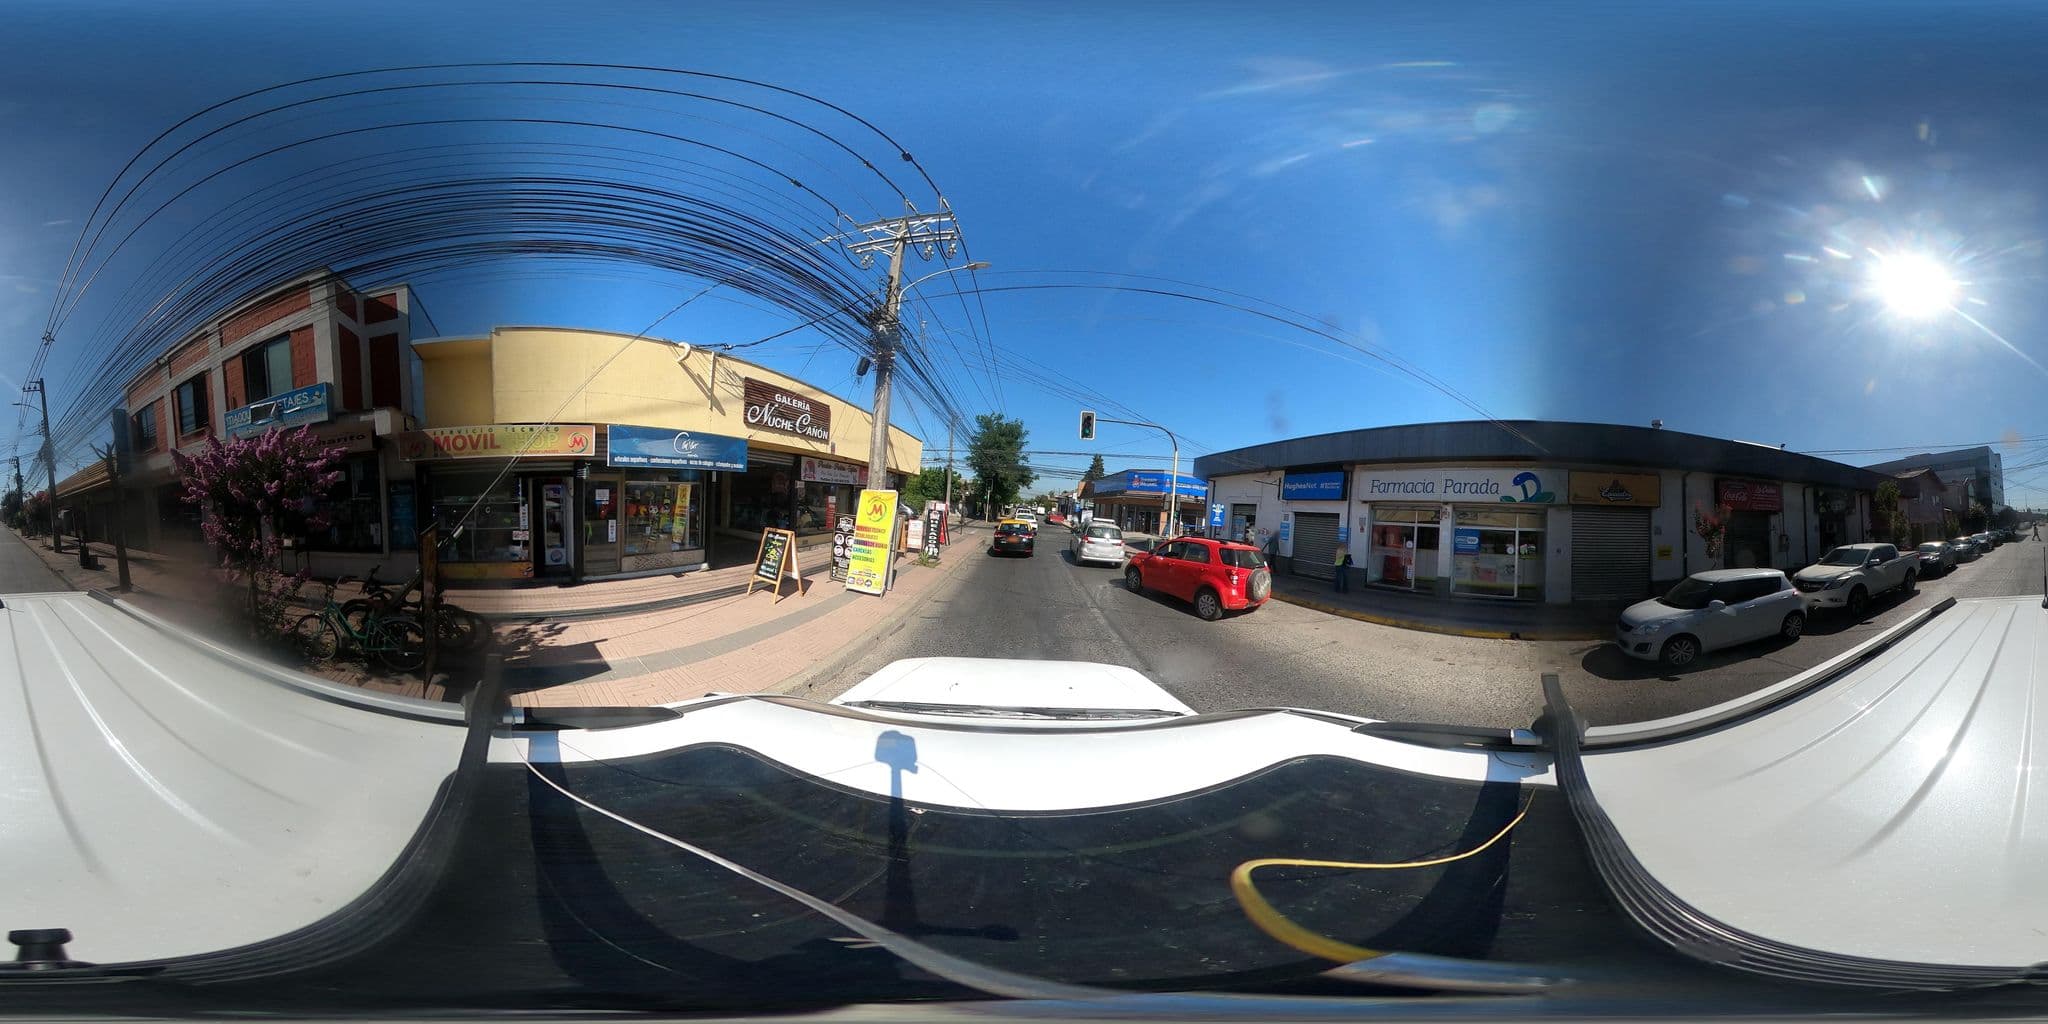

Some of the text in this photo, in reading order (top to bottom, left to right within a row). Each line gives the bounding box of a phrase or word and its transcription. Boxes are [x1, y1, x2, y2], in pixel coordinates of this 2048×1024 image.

[795, 413, 829, 440] CAÑÓN
[434, 432, 501, 451] MOVIL
[1370, 478, 1500, 495] Farmacia Parada
